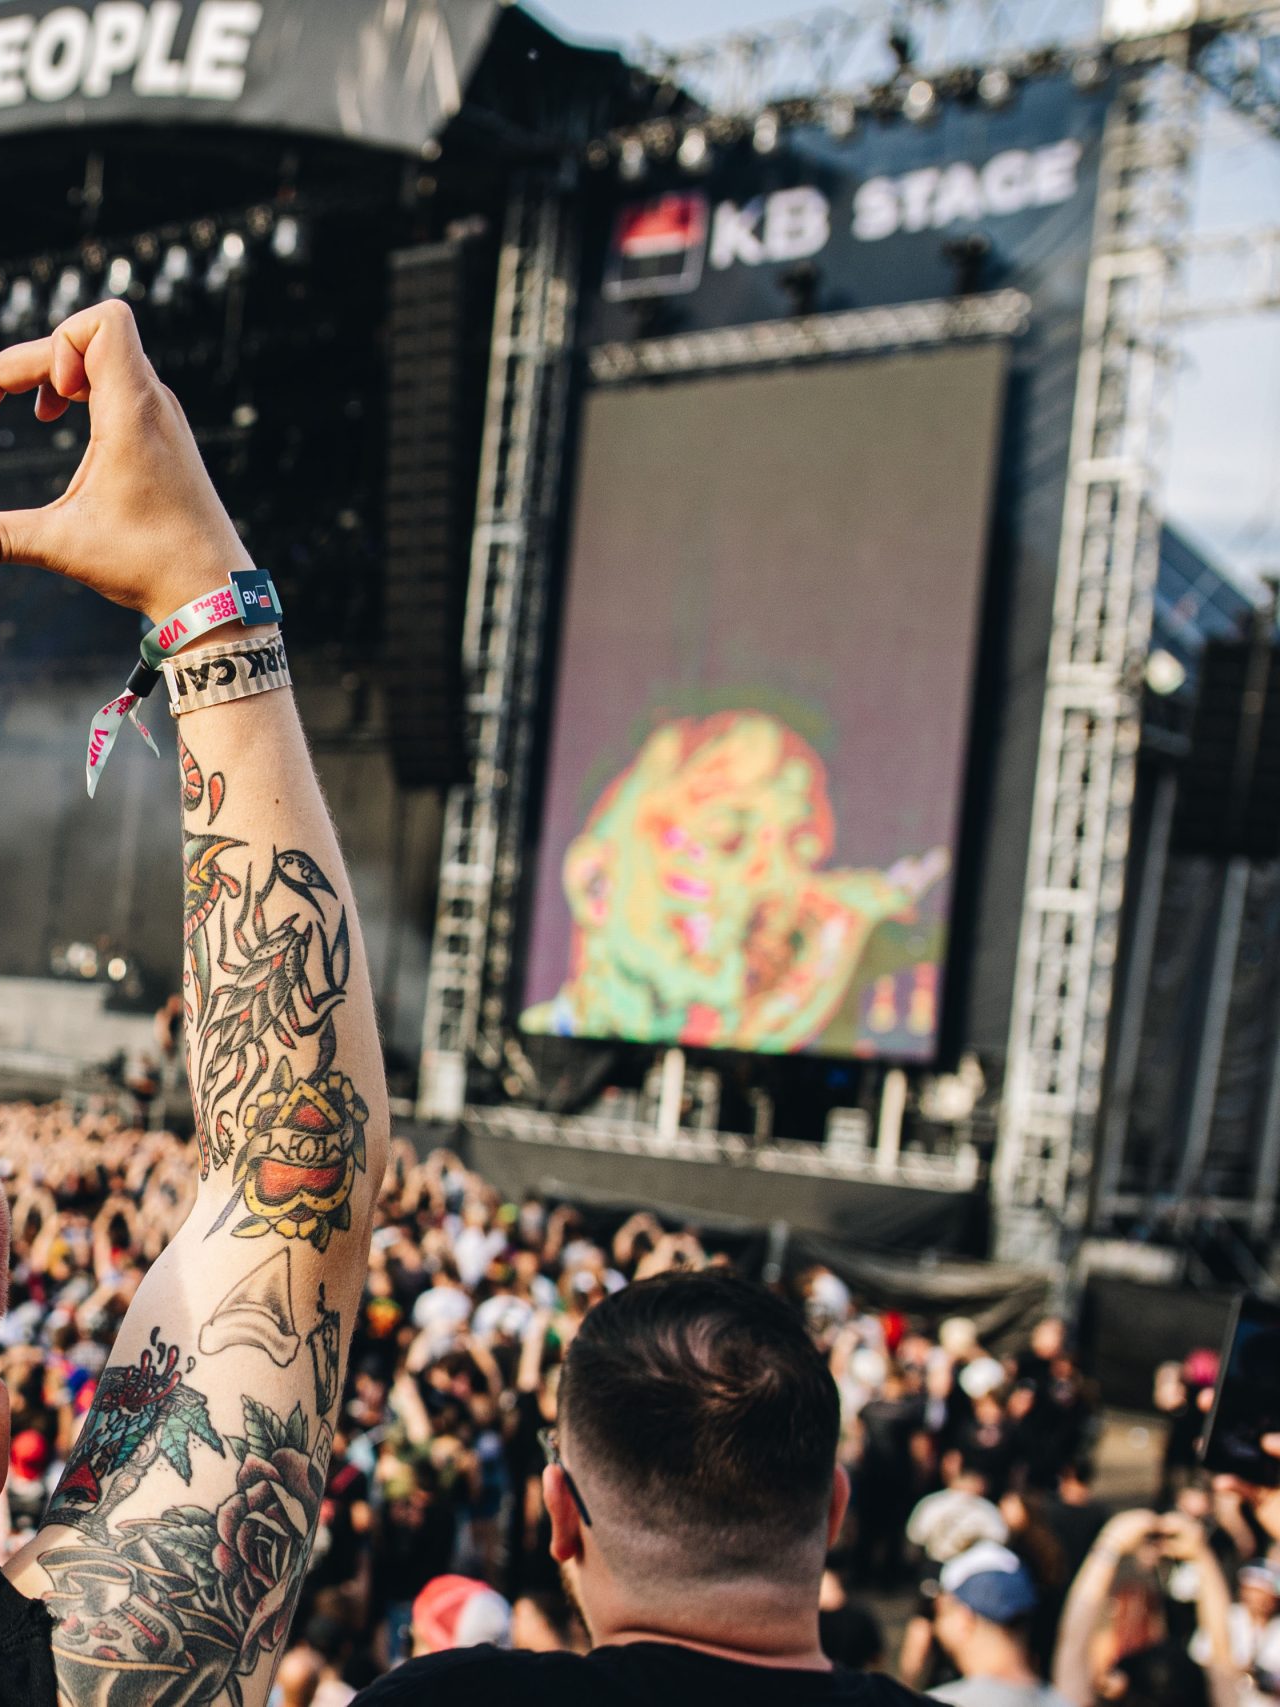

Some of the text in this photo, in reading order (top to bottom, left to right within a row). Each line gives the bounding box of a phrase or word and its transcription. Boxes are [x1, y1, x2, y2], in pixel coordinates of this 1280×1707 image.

[708, 138, 1083, 271] KB STAGE
[192, 589, 232, 614] PEOPLE
[214, 596, 235, 612] FOR
[242, 590, 258, 605] KB
[208, 605, 238, 625] ROCK
[158, 618, 189, 650] VIP
[89, 728, 109, 767] VIP
